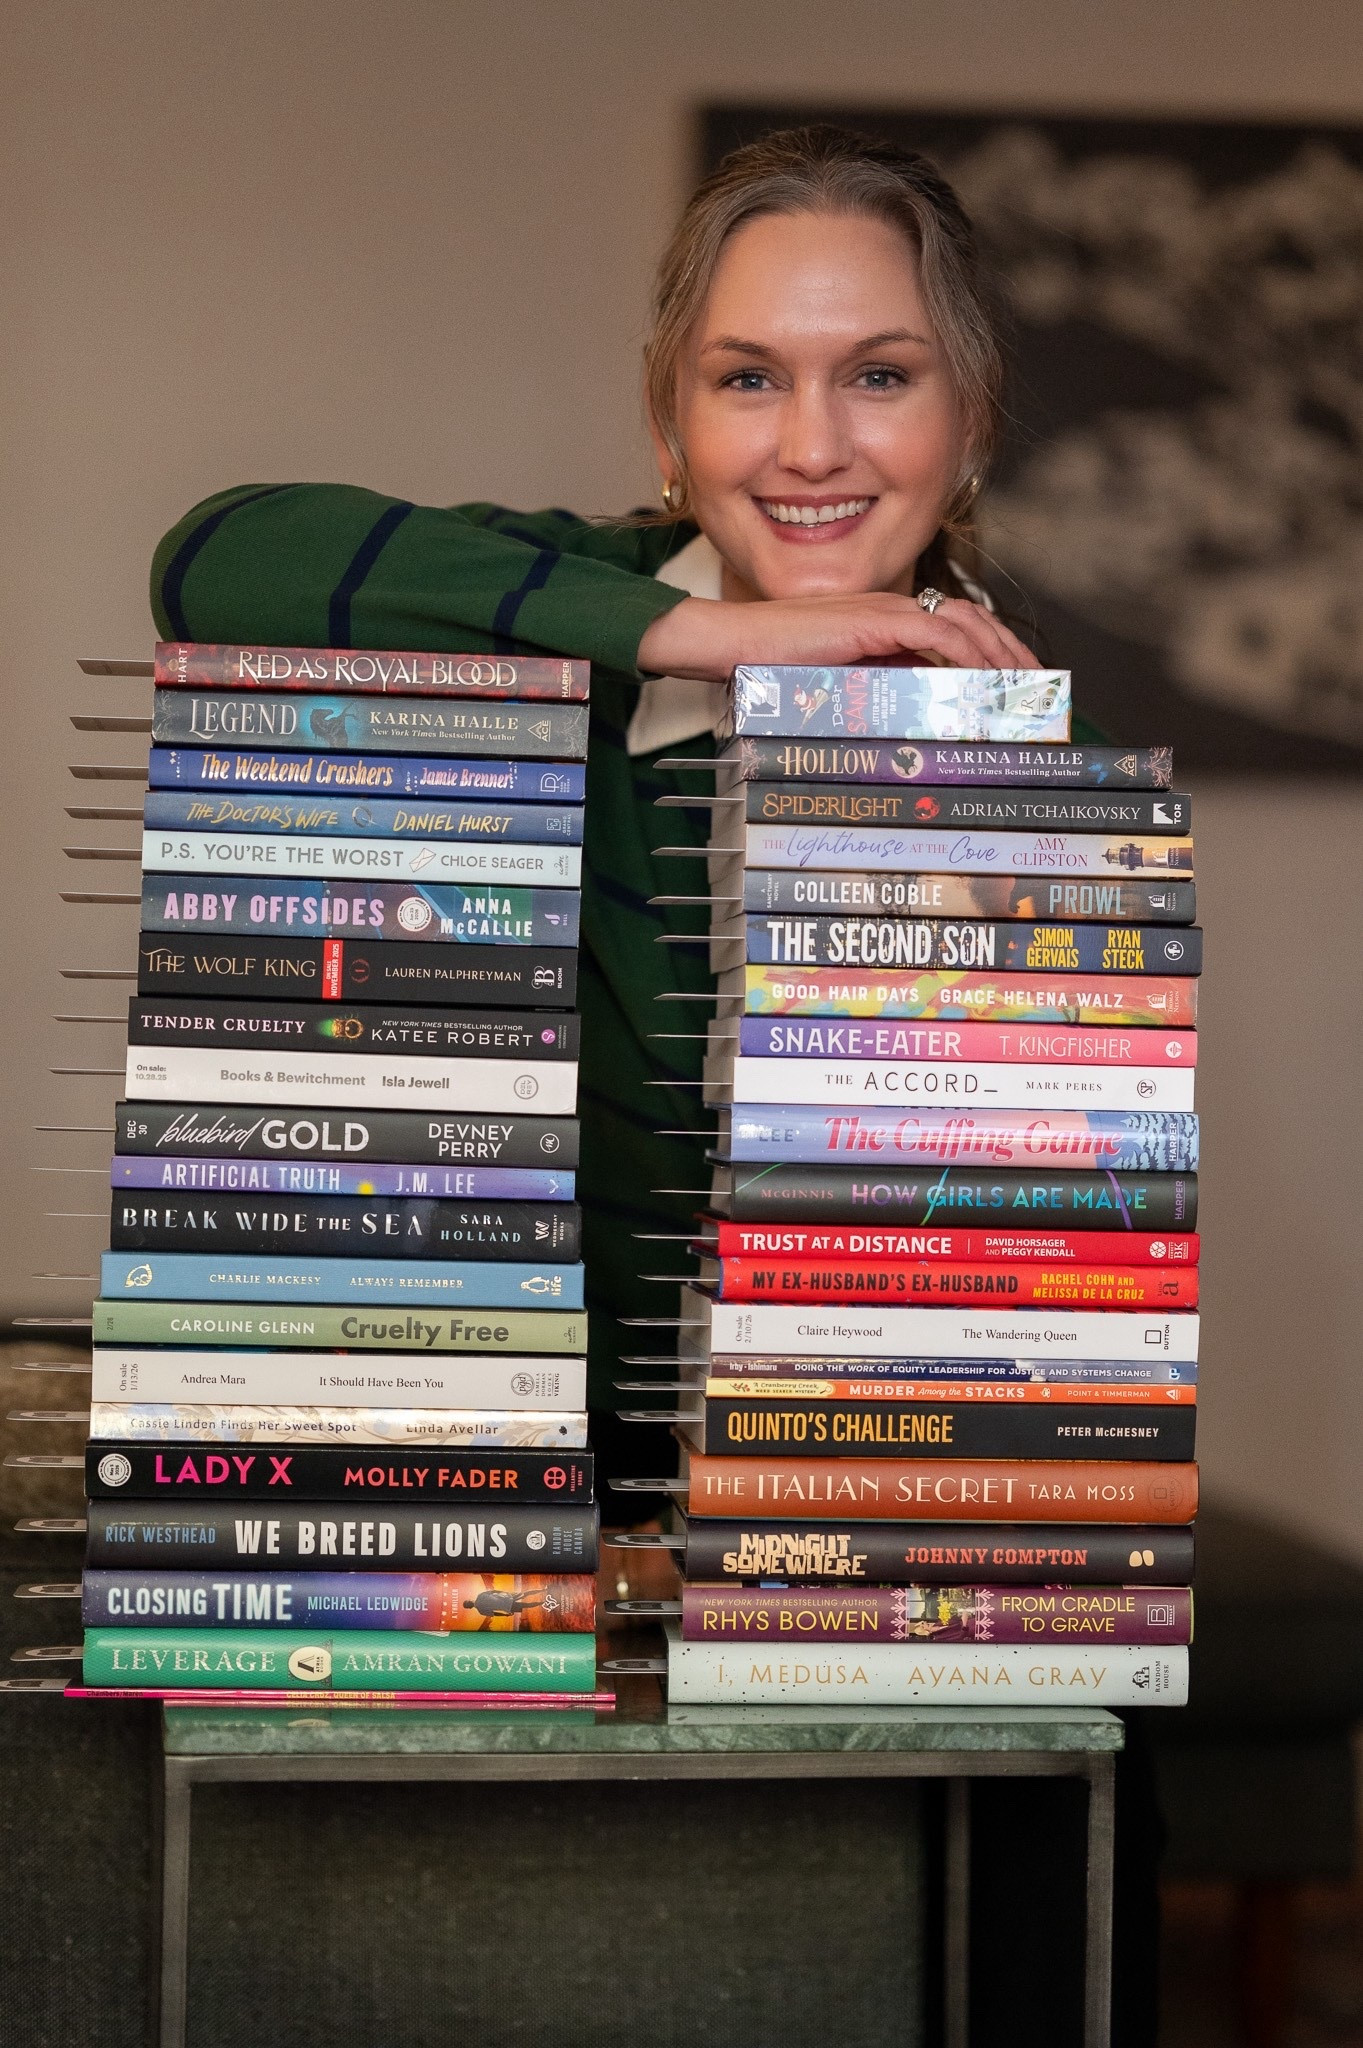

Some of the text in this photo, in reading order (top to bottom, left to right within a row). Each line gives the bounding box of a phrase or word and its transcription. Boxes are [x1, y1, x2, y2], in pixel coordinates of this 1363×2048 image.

[178, 648, 187, 682] HART
[239, 652, 517, 690] RED AS ROYAL BLOOD
[561, 662, 570, 697] HARPER
[831, 685, 844, 727] Dear
[842, 671, 869, 735] SANTA
[188, 698, 297, 738] LEGEND
[370, 711, 518, 730] KARINA HALLE
[540, 720, 549, 742] ACE
[777, 746, 880, 774] HOLLOW
[201, 755, 393, 787] The Weekend Crashers
[420, 766, 512, 788] Jamie Brenner
[958, 767, 976, 776] York
[1005, 768, 1050, 777] Bestselling
[188, 802, 339, 827] THE DOCTOR'S WIFE
[762, 792, 902, 820] SPIDERLIGHT
[1174, 803, 1182, 823] TOR
[393, 812, 513, 833] DANIEL HURST
[1034, 837, 1067, 851] AMY
[162, 842, 403, 867] P.S. YOU'RE THE WORST
[1013, 851, 1088, 868] CLIPSTON
[794, 880, 942, 906] COLLEEN COBLE
[1049, 885, 1126, 916] PROWL
[164, 893, 237, 920] ABBY
[250, 895, 385, 926] OFFSIDES
[462, 898, 512, 913] ANNA
[441, 917, 532, 936] McCALLIE
[1033, 928, 1073, 947] SIMON
[1108, 929, 1140, 948] RYAN
[142, 947, 317, 978] THE WOLF KING
[1026, 947, 1079, 967] GERVAIS
[1103, 948, 1144, 968] STECK
[385, 968, 521, 982] LAUREN PALPHREYMAN
[772, 985, 919, 1002] GOOD HAIR DAYS
[141, 1016, 306, 1033] TENDER CRUELTY
[769, 1026, 962, 1056] SNAKE-EATER
[1000, 1036, 1132, 1058] T. KINGFISHER
[221, 1069, 365, 1086] Books & Bewitchment
[1026, 1081, 1103, 1092] MARK PERES
[127, 1120, 137, 1138] DEC
[139, 1124, 147, 1134] 30
[156, 1113, 369, 1152] bluebird GOLD
[428, 1123, 513, 1142] DEVNEY
[439, 1142, 502, 1158] PERRY
[1169, 1122, 1179, 1162] HARPER
[162, 1164, 340, 1190] ARTIFICIAL TRUTH
[762, 1189, 834, 1199] McGINNIS
[1175, 1181, 1184, 1219] HARPER
[460, 1213, 504, 1226] SARA
[441, 1231, 522, 1243] HOLLAND
[986, 1237, 1066, 1247] DAVID HORSAGER
[1002, 1247, 1030, 1256] PEGGY
[1033, 1247, 1075, 1257] KENDALL
[1174, 1243, 1182, 1259] BK
[210, 1274, 321, 1286] CHARLIE MACKESY
[551, 1276, 561, 1296] life
[1041, 1273, 1134, 1286] RACHEL COHN AND
[170, 1319, 315, 1335] CAROLINE GLENN
[341, 1317, 509, 1346] Cruelty Free
[735, 1330, 742, 1342] On
[798, 1325, 882, 1339] Claire Heywood
[120, 1379, 126, 1391] On
[130, 1363, 138, 1391] 1/13/26
[181, 1373, 246, 1385] Andrea Mara
[850, 1384, 1025, 1398] MURDER Among the STACKS
[728, 1412, 952, 1443] QUINTO'S CHALLENGE
[1057, 1426, 1160, 1438] PETER McCHESNEY
[156, 1455, 256, 1484] LADY
[269, 1457, 292, 1485] X
[345, 1468, 518, 1489] MOLLY FADER
[1029, 1484, 1135, 1500] TARA MOSS
[106, 1526, 216, 1545] RICK WESTHEAD
[553, 1526, 561, 1554] RANDOM
[563, 1530, 571, 1551] HOUSE
[574, 1527, 582, 1554] CANADA
[905, 1547, 1087, 1566] JOHNNY COMPTON
[108, 1583, 292, 1620] CLOSING TIME
[308, 1596, 428, 1612] MICHAEL LEDWIDGE
[704, 1611, 878, 1631] RHYS BOWEN
[112, 1649, 275, 1672] LEVERAGE
[343, 1654, 568, 1674] AMRAN GOWANI
[908, 1667, 1107, 1687] AYANA GRAY
